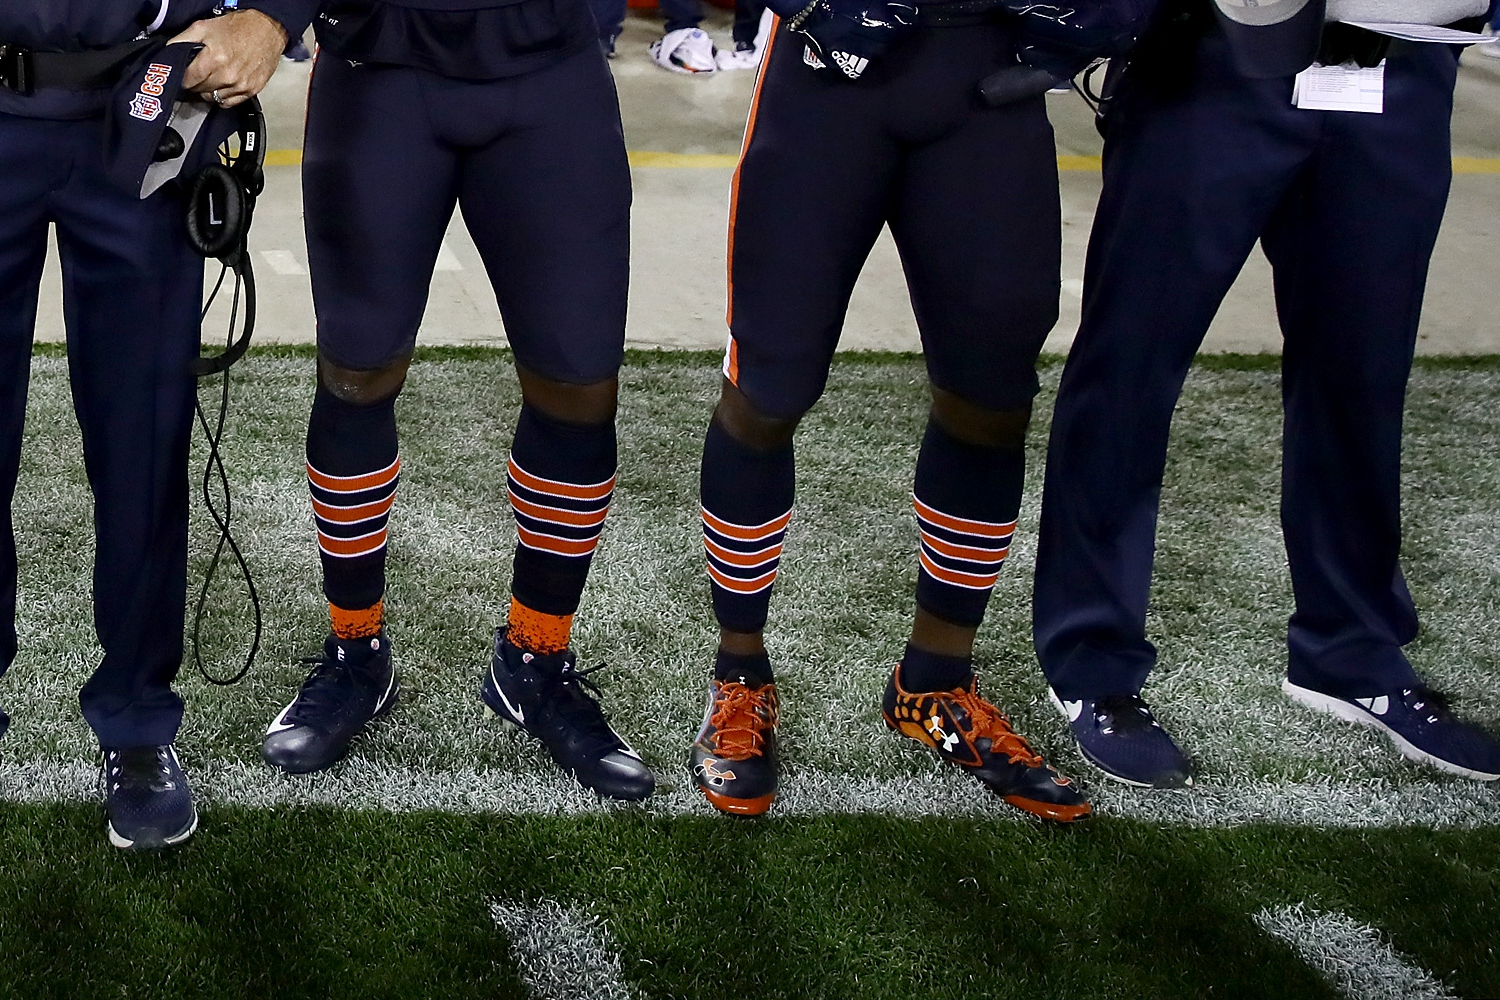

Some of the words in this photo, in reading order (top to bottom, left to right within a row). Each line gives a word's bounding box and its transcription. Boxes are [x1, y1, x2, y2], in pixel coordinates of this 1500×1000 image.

[140, 62, 174, 97] GSH
[831, 50, 862, 81] adidas
[208, 192, 223, 225] L
